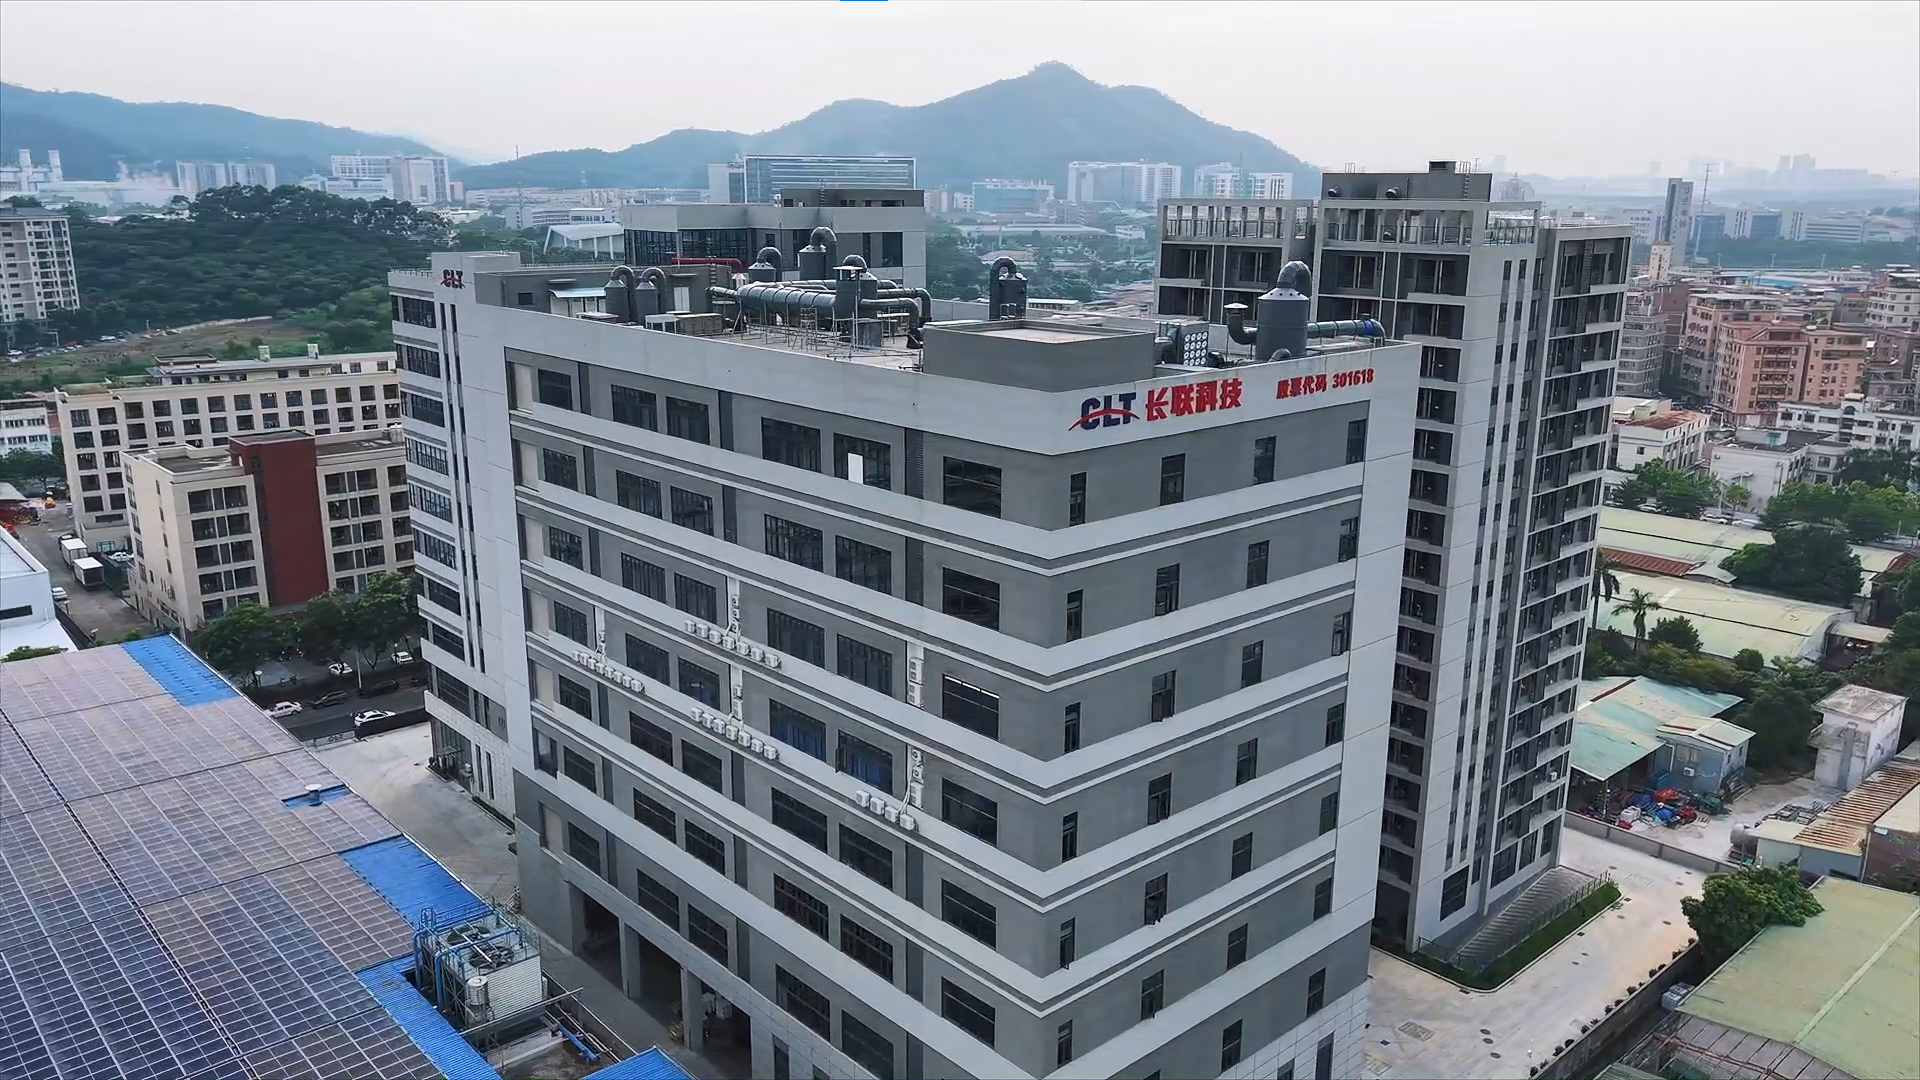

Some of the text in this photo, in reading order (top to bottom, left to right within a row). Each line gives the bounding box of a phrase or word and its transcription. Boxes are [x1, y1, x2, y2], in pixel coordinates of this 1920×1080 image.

[442, 269, 464, 289] CLT
[1332, 368, 1374, 389] 301618
[1079, 378, 1243, 431] CLT 长联科技
